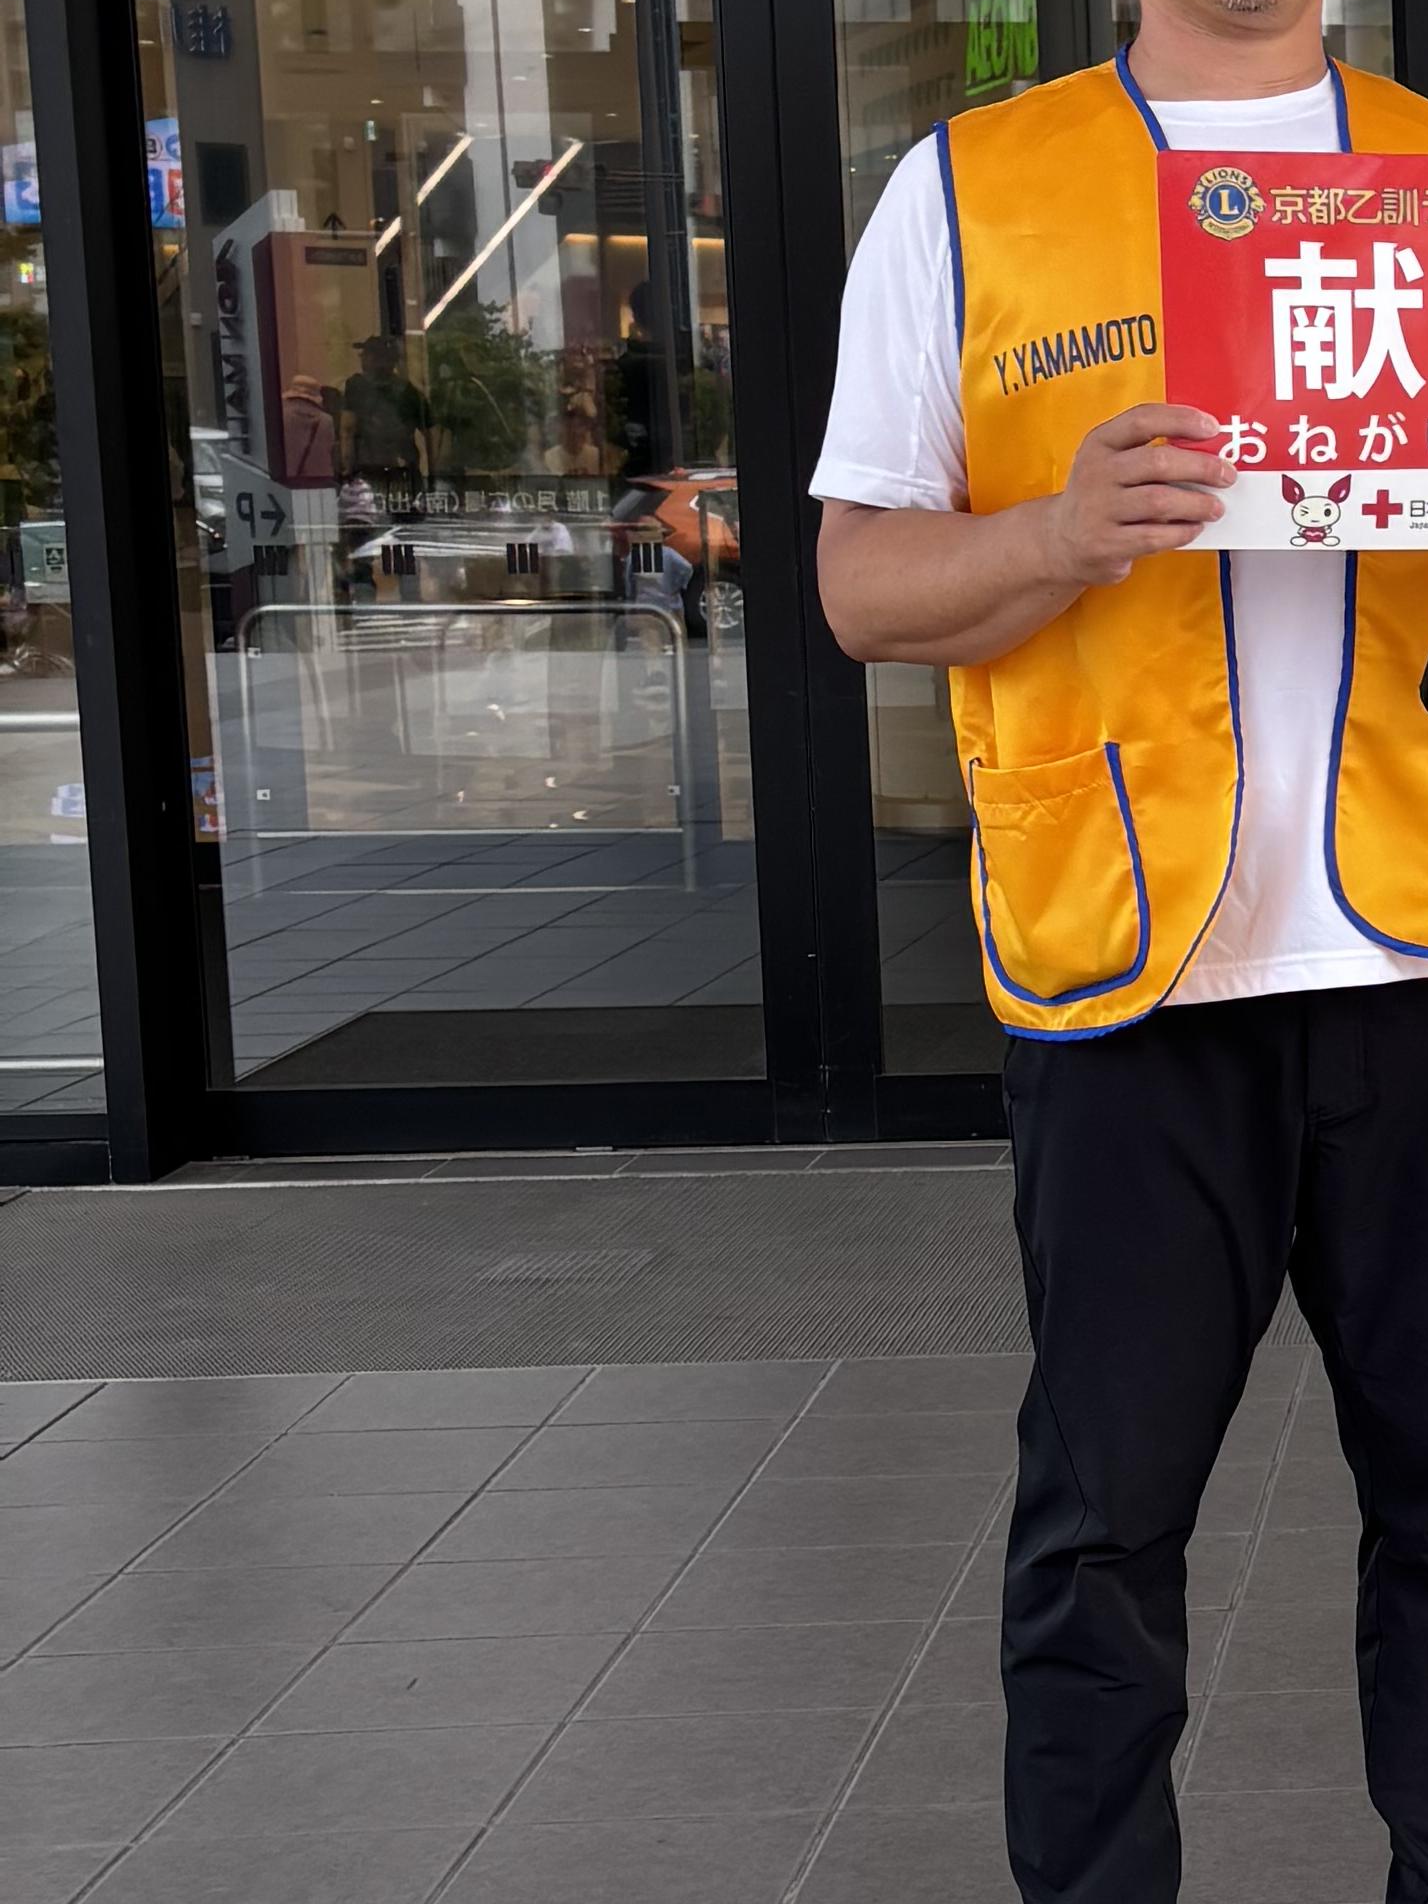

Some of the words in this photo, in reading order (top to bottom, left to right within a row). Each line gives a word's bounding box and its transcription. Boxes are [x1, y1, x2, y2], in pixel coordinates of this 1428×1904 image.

[1204, 168, 1249, 186] LIONS
[1219, 189, 1239, 215] L
[994, 314, 1157, 395] Y.YAMAMOTO
